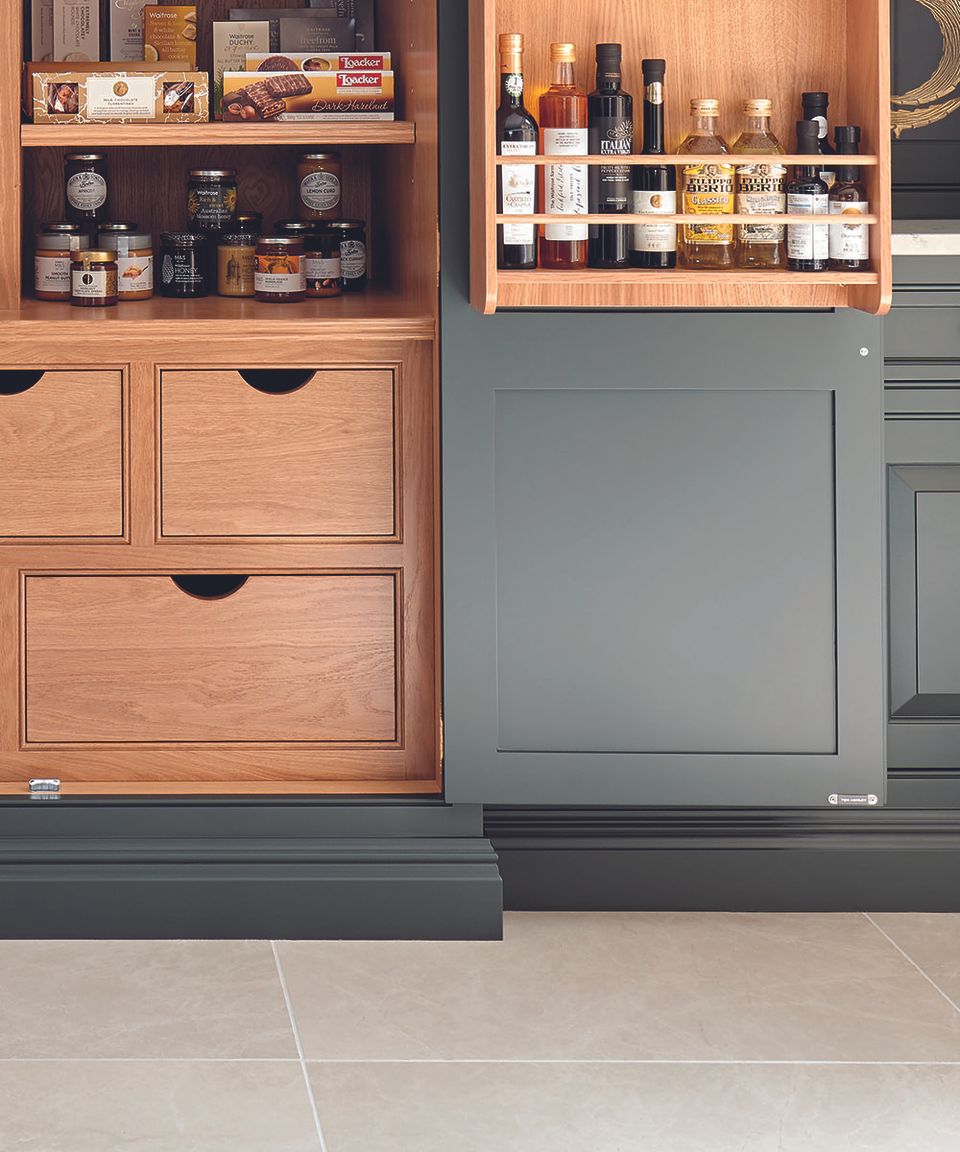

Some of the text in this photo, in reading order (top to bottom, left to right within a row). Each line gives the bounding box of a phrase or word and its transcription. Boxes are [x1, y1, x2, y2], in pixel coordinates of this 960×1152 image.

[300, 36, 337, 44] freefrom
[340, 57, 380, 68] Loacker
[339, 74, 379, 86] Loacker
[312, 99, 388, 111] Dark Hazelnut
[601, 140, 631, 150] ITALIAN
[687, 184, 733, 192] BERIO
[740, 184, 785, 192] BERIO
[691, 195, 729, 205] CLASSICO
